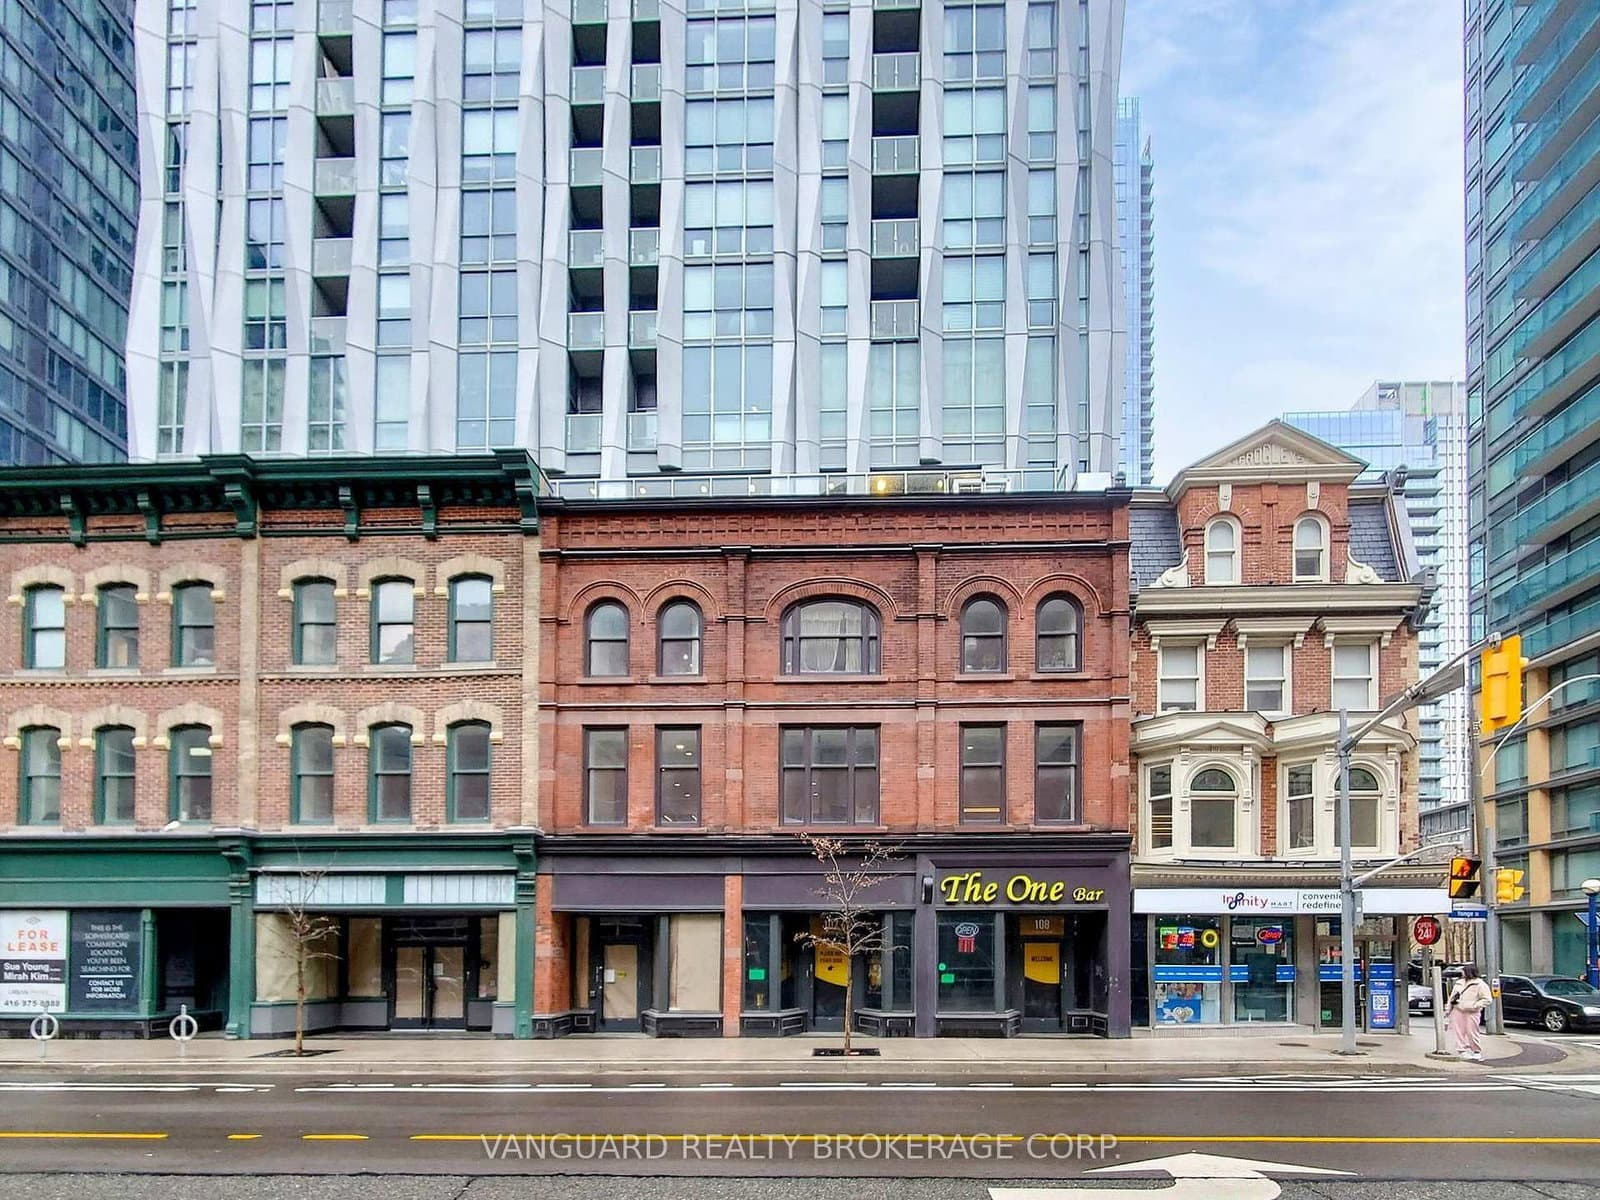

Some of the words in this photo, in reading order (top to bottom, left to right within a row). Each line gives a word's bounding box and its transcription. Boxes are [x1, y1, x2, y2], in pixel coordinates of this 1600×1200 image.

[941, 872, 998, 902] The
[1007, 875, 1065, 902] One
[1073, 887, 1104, 901] Bar
[1222, 892, 1268, 910] Infinity
[1302, 901, 1343, 909] redefine
[18, 930, 48, 939] FOR
[8, 942, 58, 952] LEASE
[22, 962, 49, 972] Young
[30, 972, 49, 980] Kim
